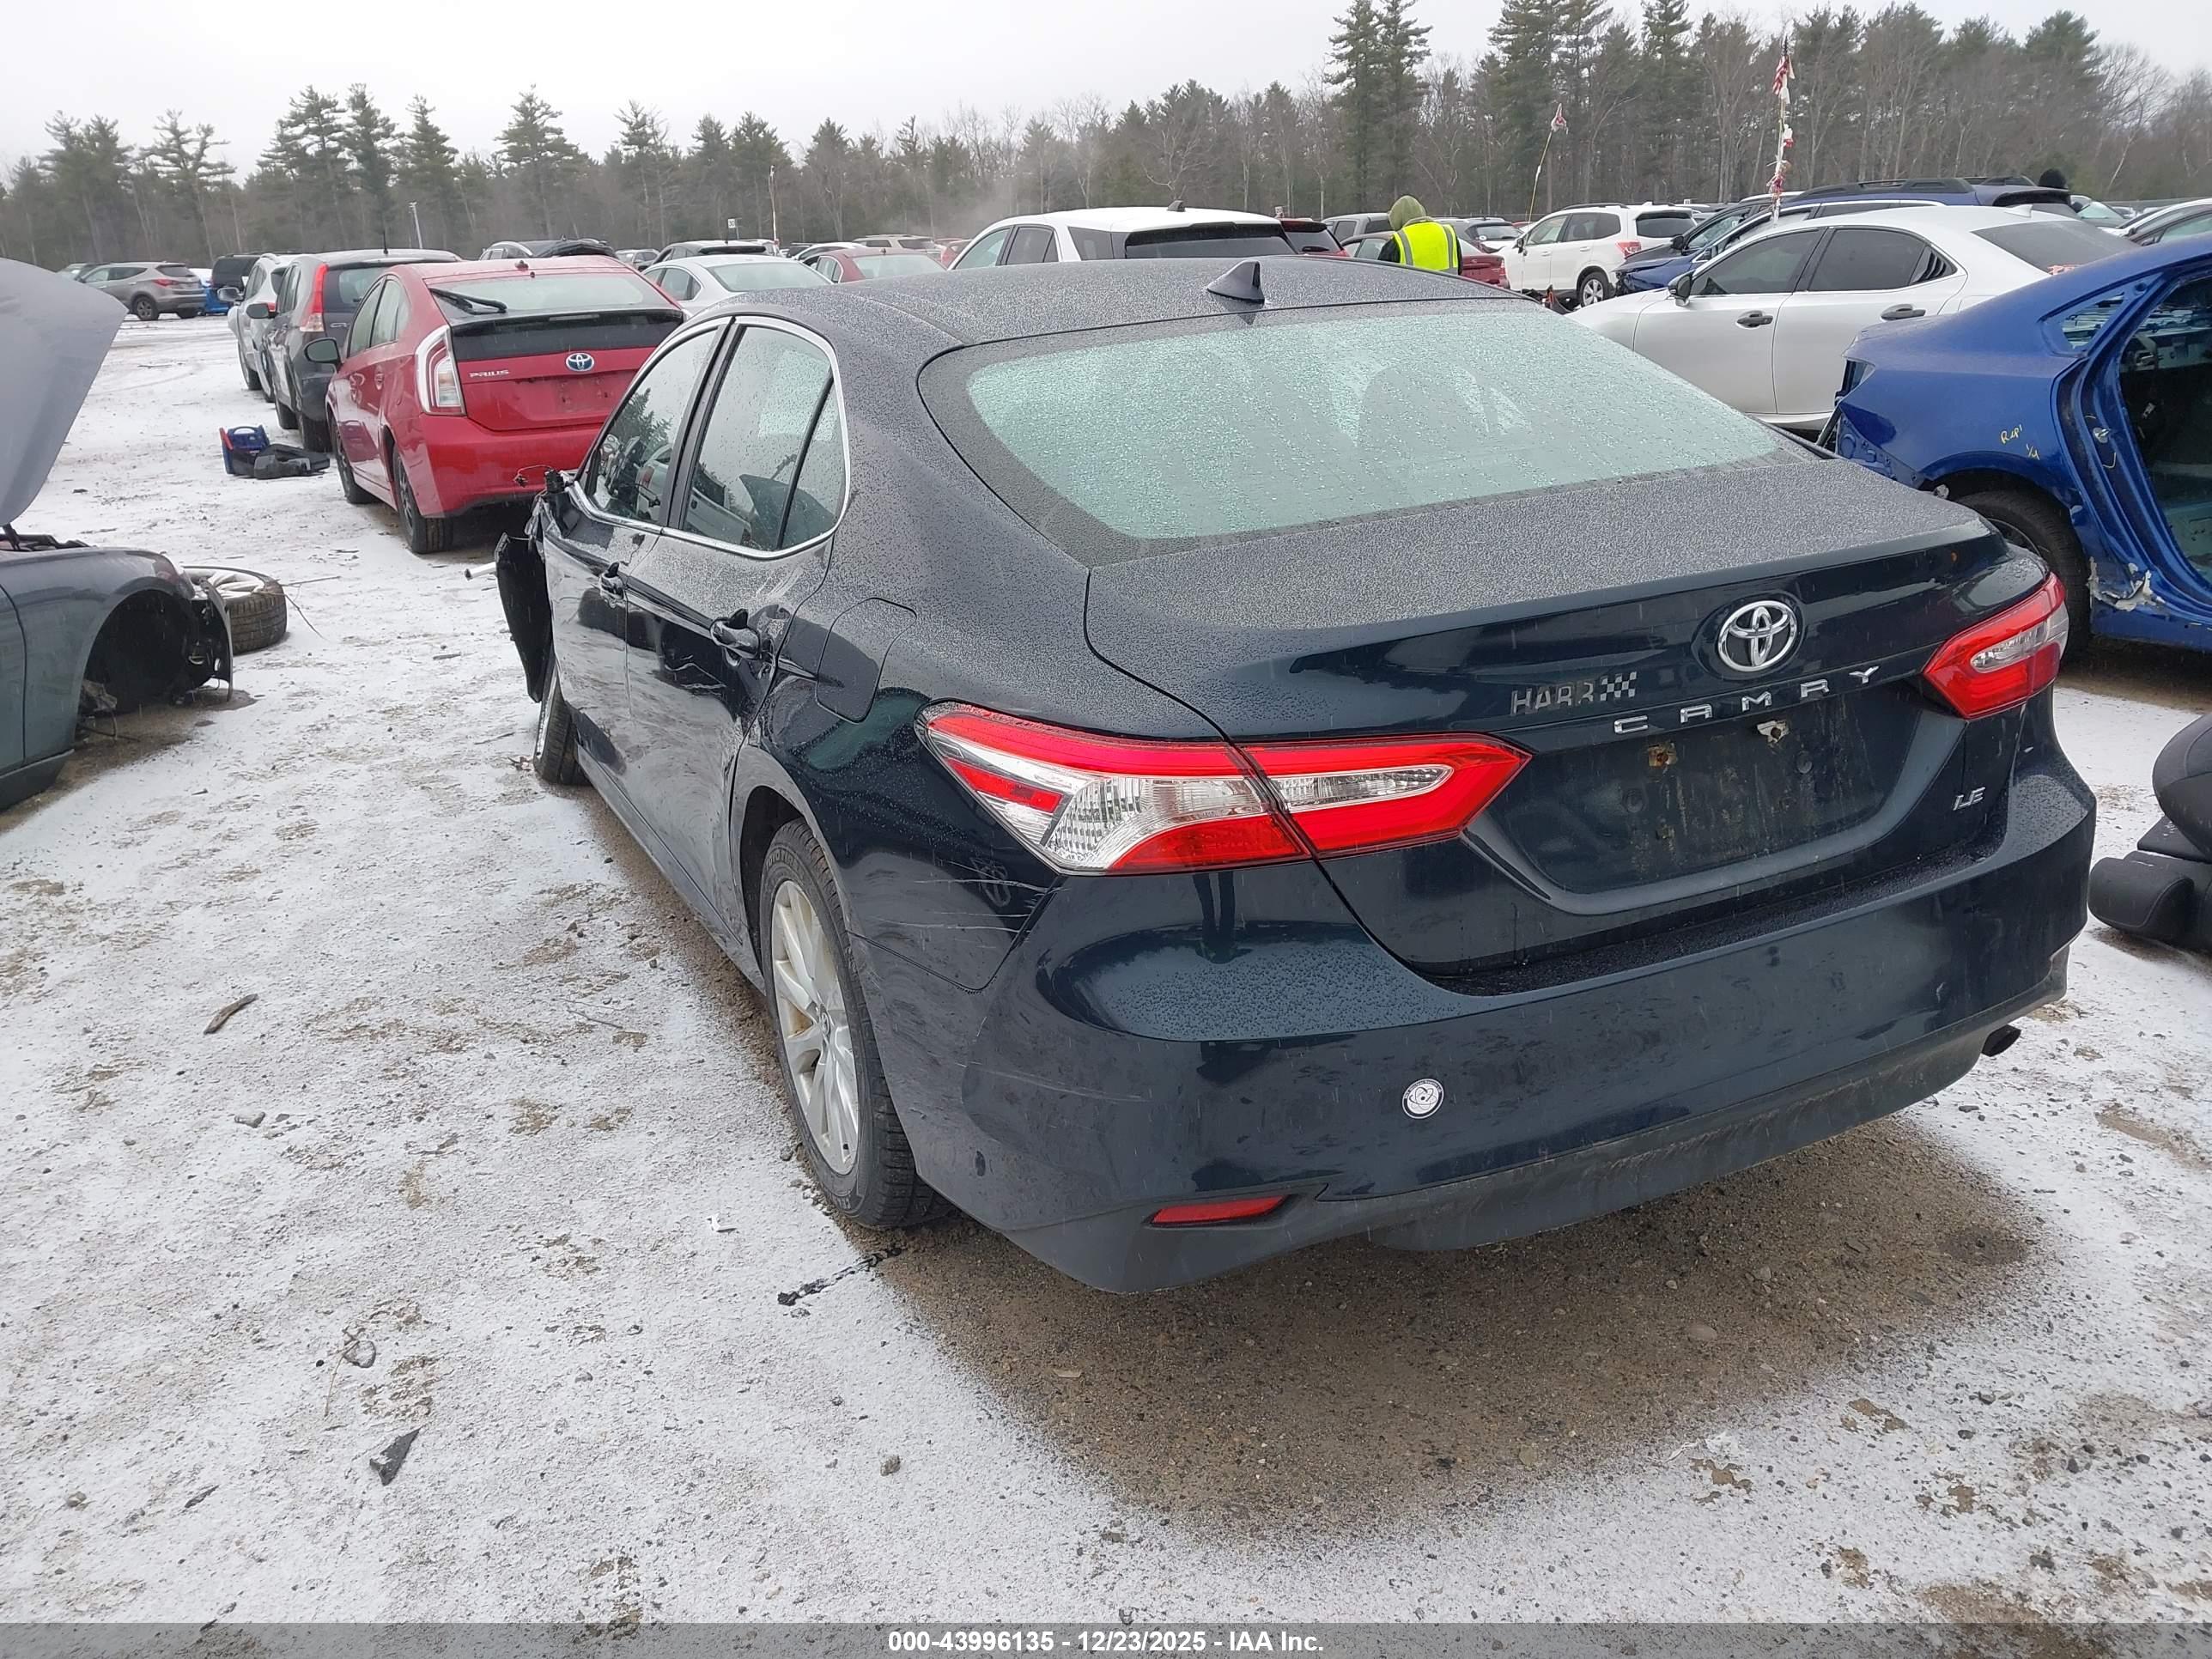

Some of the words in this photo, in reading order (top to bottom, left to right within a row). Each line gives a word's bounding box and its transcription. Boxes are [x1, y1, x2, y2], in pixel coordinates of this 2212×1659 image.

[468, 369, 510, 378] PRIUS
[1613, 665, 1879, 734] CAMRY
[1952, 787, 1986, 811] LE
